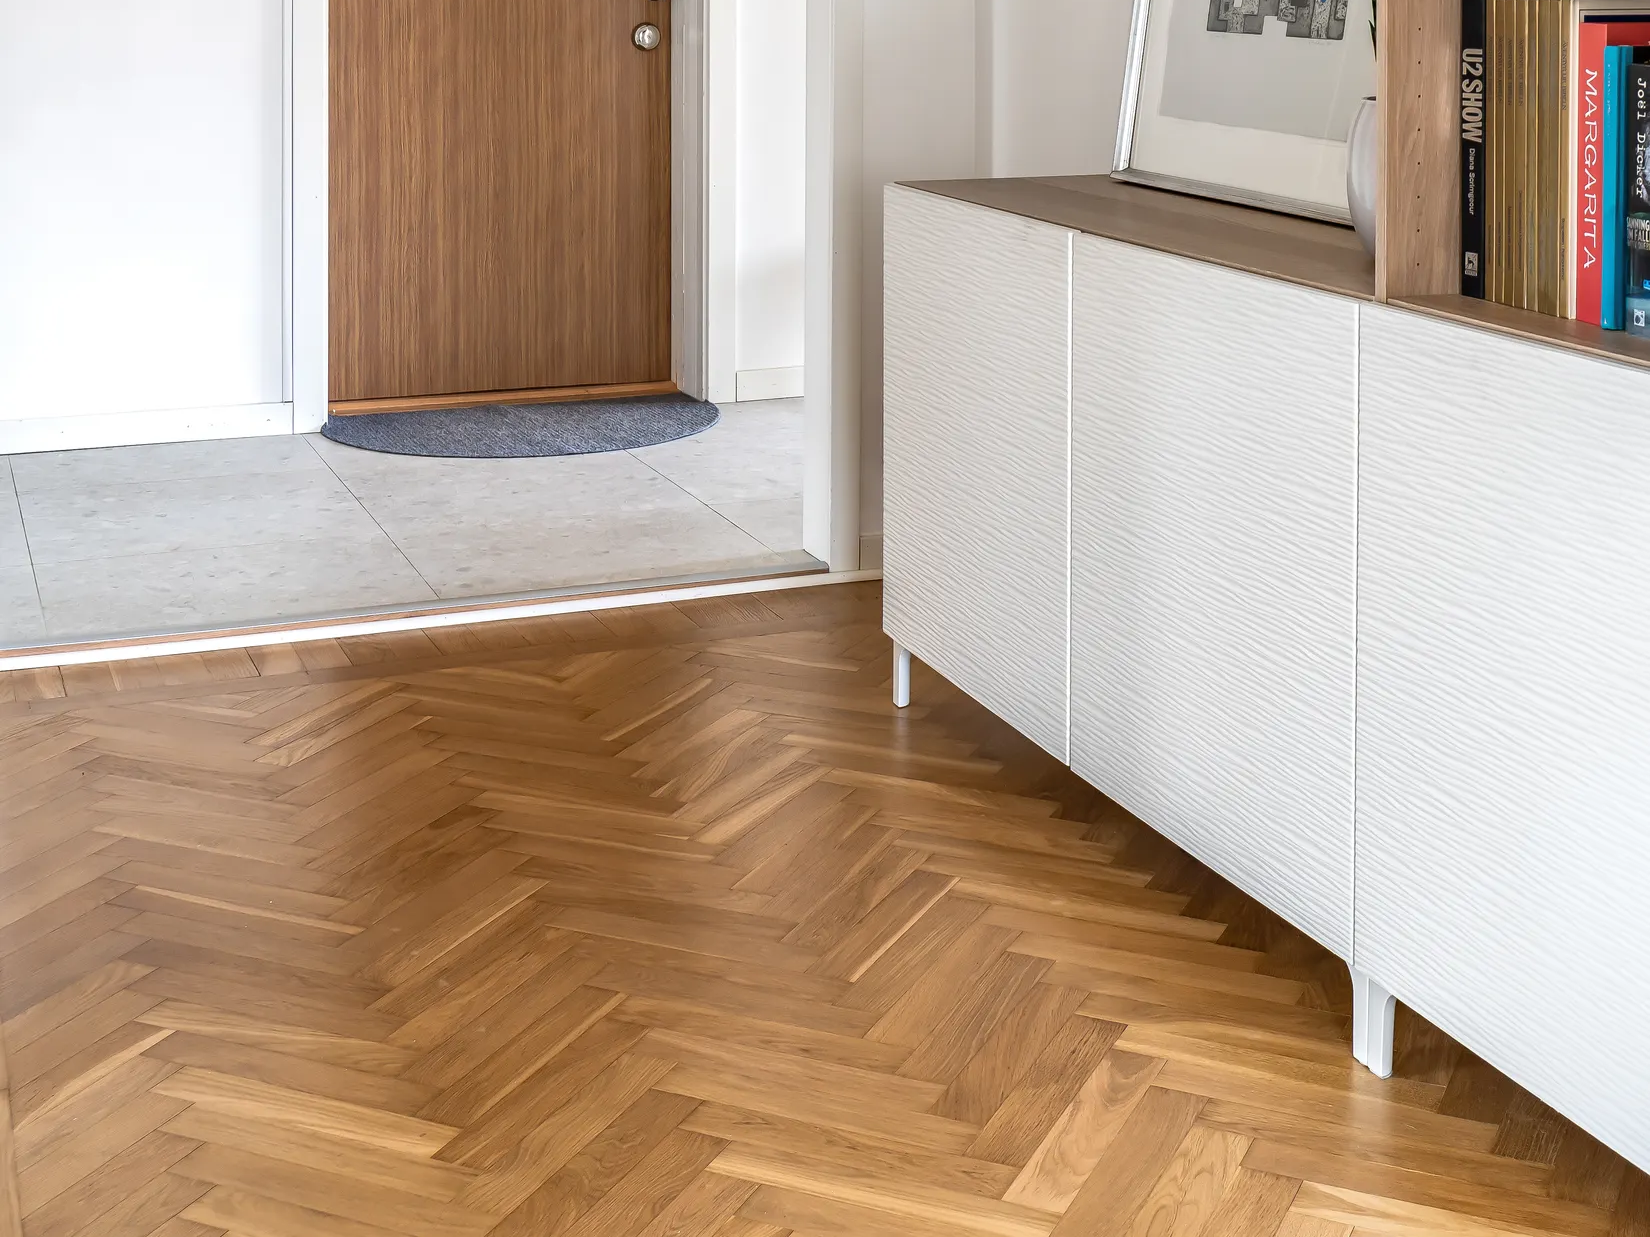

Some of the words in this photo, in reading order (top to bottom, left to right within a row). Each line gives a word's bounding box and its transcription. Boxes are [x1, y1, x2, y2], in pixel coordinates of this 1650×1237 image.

[1462, 48, 1483, 76] U2
[1462, 79, 1483, 143] SHOW
[1637, 78, 1647, 120] Joël
[1583, 68, 1598, 268] MARGARITA
[1635, 131, 1646, 199] Dicker
